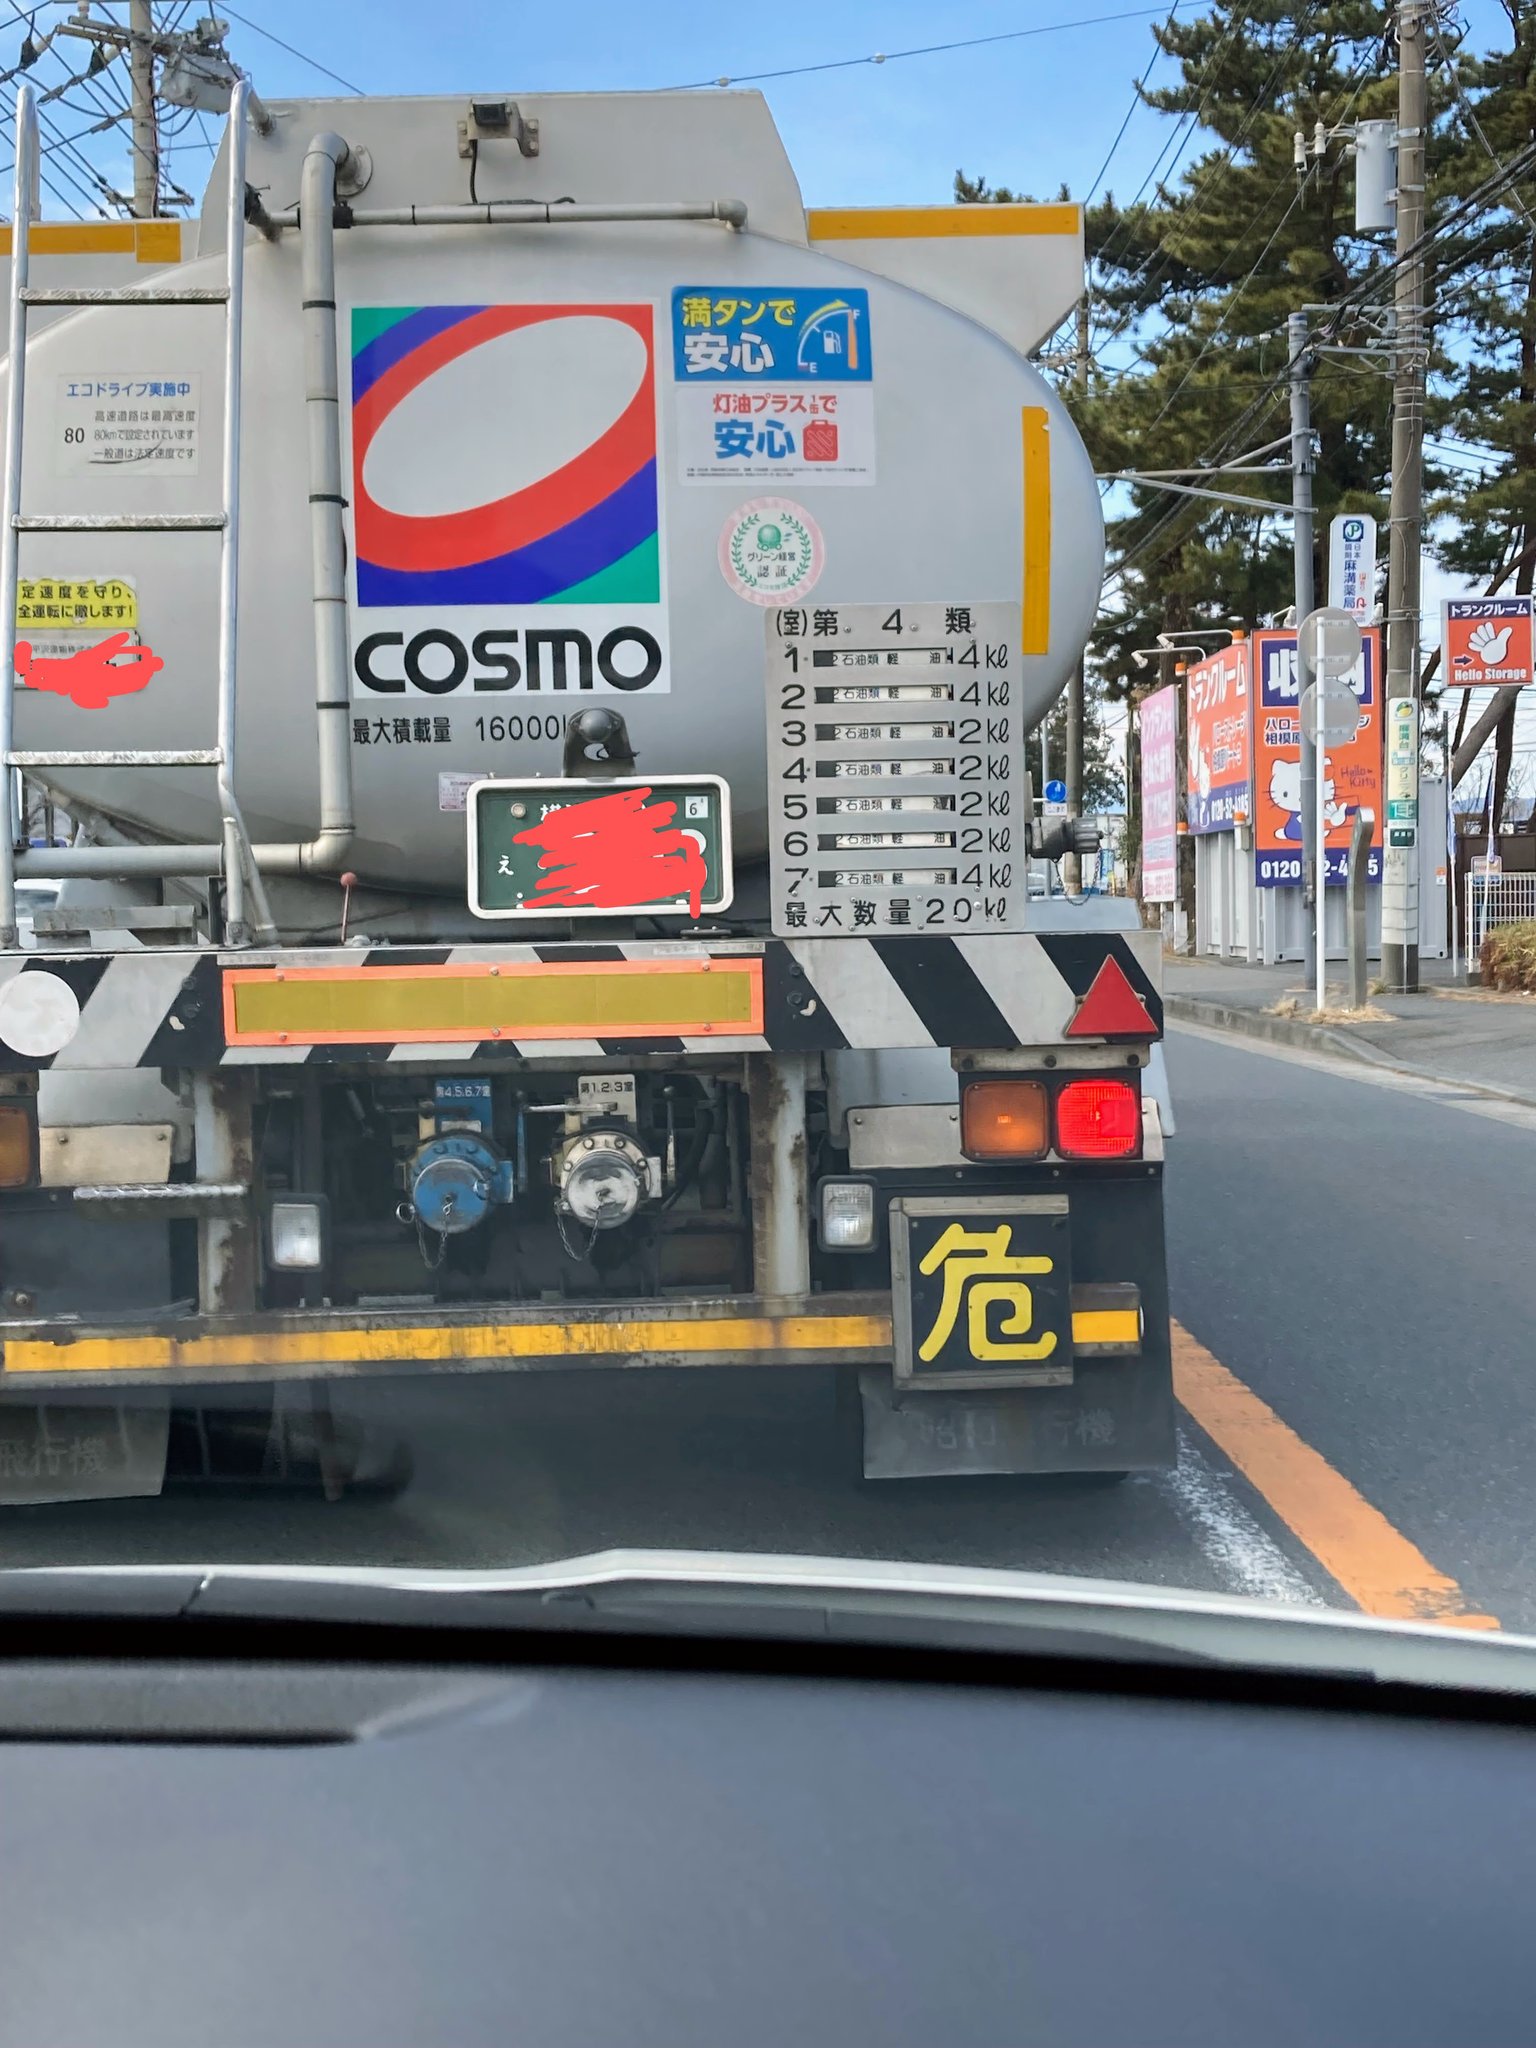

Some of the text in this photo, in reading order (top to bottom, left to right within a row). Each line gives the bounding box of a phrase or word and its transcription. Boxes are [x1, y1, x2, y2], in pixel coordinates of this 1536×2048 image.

[682, 297, 795, 327] 満タンで
[853, 309, 860, 320] F
[684, 332, 774, 374] 安心
[809, 362, 817, 373] E
[67, 382, 190, 397] エコドライブ実施中
[95, 410, 196, 422] 高速道路は最高速度
[64, 427, 85, 443] 80
[715, 419, 795, 459] 安心
[882, 609, 903, 635] 4
[945, 607, 972, 634] 類
[1451, 603, 1528, 617] トランクルーム
[354, 626, 662, 694] COSMO
[784, 647, 798, 673] 1
[1188, 651, 1247, 717] トランクルーム
[1454, 667, 1527, 681] Hello Storage
[781, 684, 805, 710] 2
[353, 716, 452, 744] 最大積載量
[781, 720, 807, 746] 3
[782, 757, 807, 783] 4
[1340, 765, 1375, 789] Hello Kitty
[784, 794, 807, 820] 5
[784, 831, 808, 857] 6
[498, 855, 514, 875] え
[784, 868, 809, 894] 7
[918, 1223, 1058, 1362] 危
